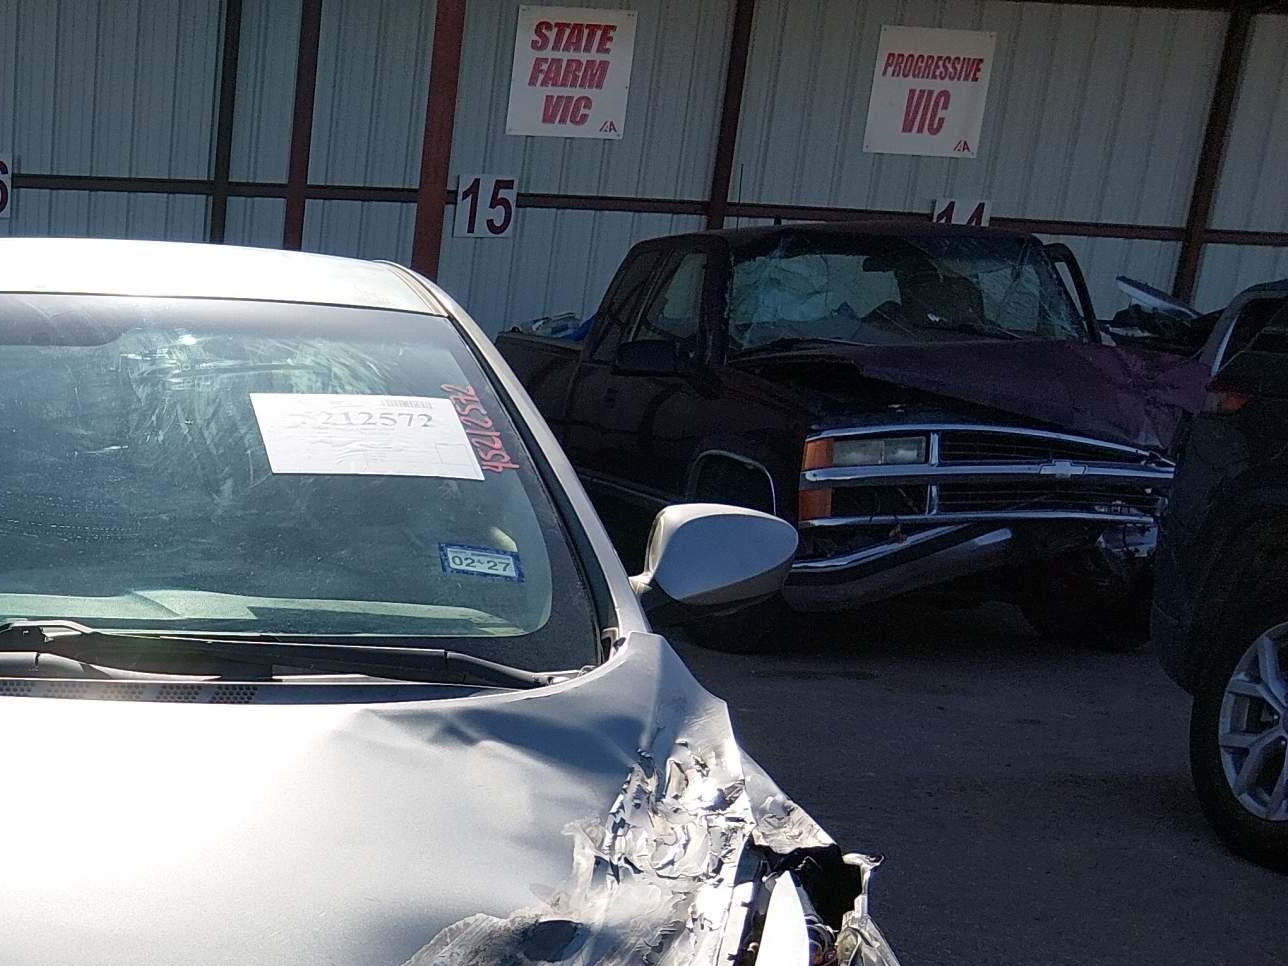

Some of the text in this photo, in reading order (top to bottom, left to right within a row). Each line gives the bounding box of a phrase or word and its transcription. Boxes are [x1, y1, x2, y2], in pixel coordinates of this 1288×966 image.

[530, 21, 618, 55] STATE
[527, 56, 611, 90] FARM
[882, 52, 985, 83] PROGRESSIVE
[541, 94, 593, 126] VIC
[901, 88, 952, 136] VIC
[461, 177, 515, 235] 15
[288, 412, 434, 428] 212572
[440, 383, 520, 473] 45212572
